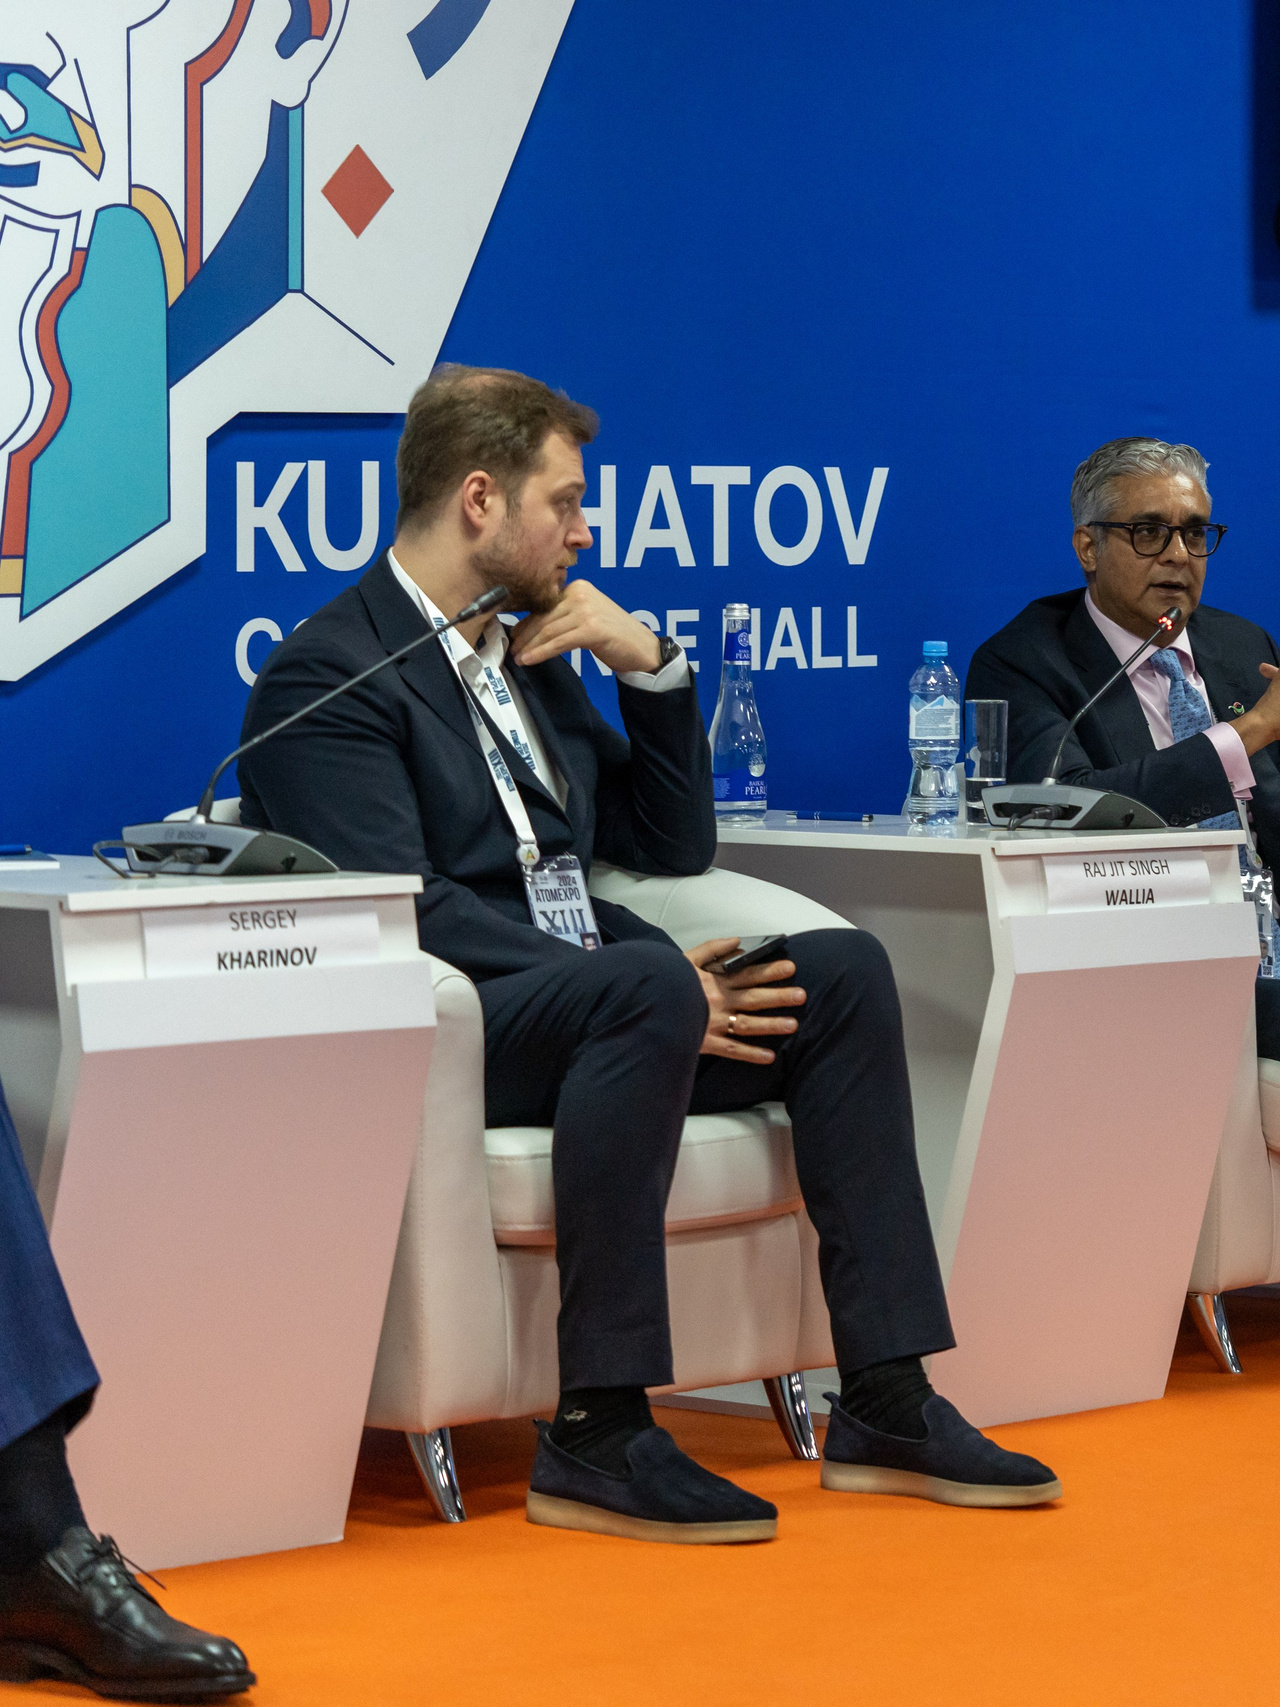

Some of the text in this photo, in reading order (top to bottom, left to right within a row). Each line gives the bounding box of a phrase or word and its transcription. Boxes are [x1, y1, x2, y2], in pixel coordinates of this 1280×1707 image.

[1083, 859, 1170, 878] RAJ JIT SINGH
[557, 875, 578, 887] 2024
[535, 887, 580, 903] ATOMEXPO
[1105, 888, 1155, 906] WALLIA
[229, 909, 297, 931] SERGEY
[217, 946, 317, 971] KHARINOV
